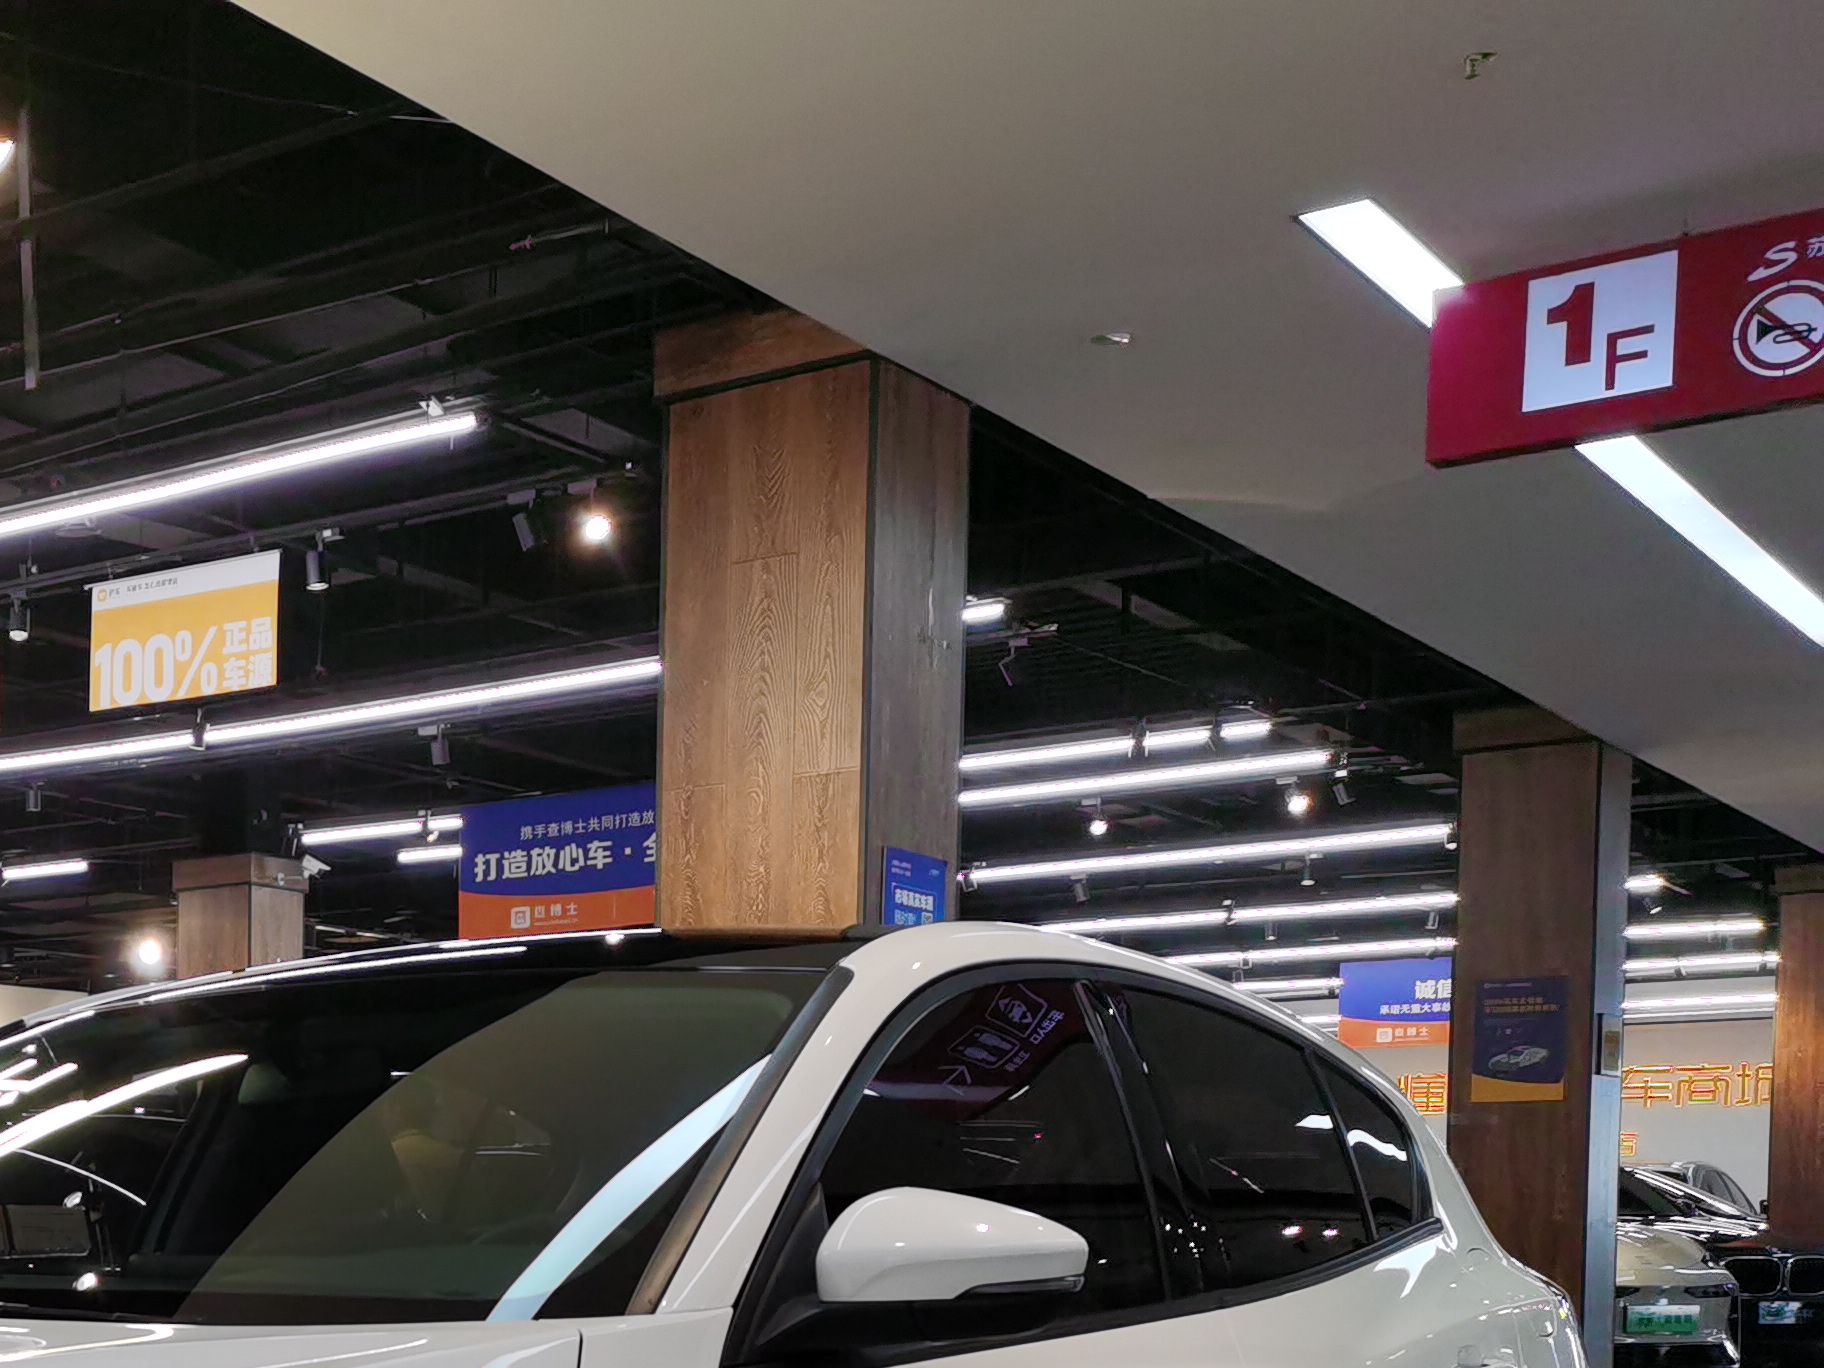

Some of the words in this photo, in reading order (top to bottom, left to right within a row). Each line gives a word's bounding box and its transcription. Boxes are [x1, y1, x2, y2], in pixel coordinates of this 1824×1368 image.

[222, 616, 273, 655] 正品
[94, 625, 219, 708] 100%
[222, 651, 274, 692] 车源
